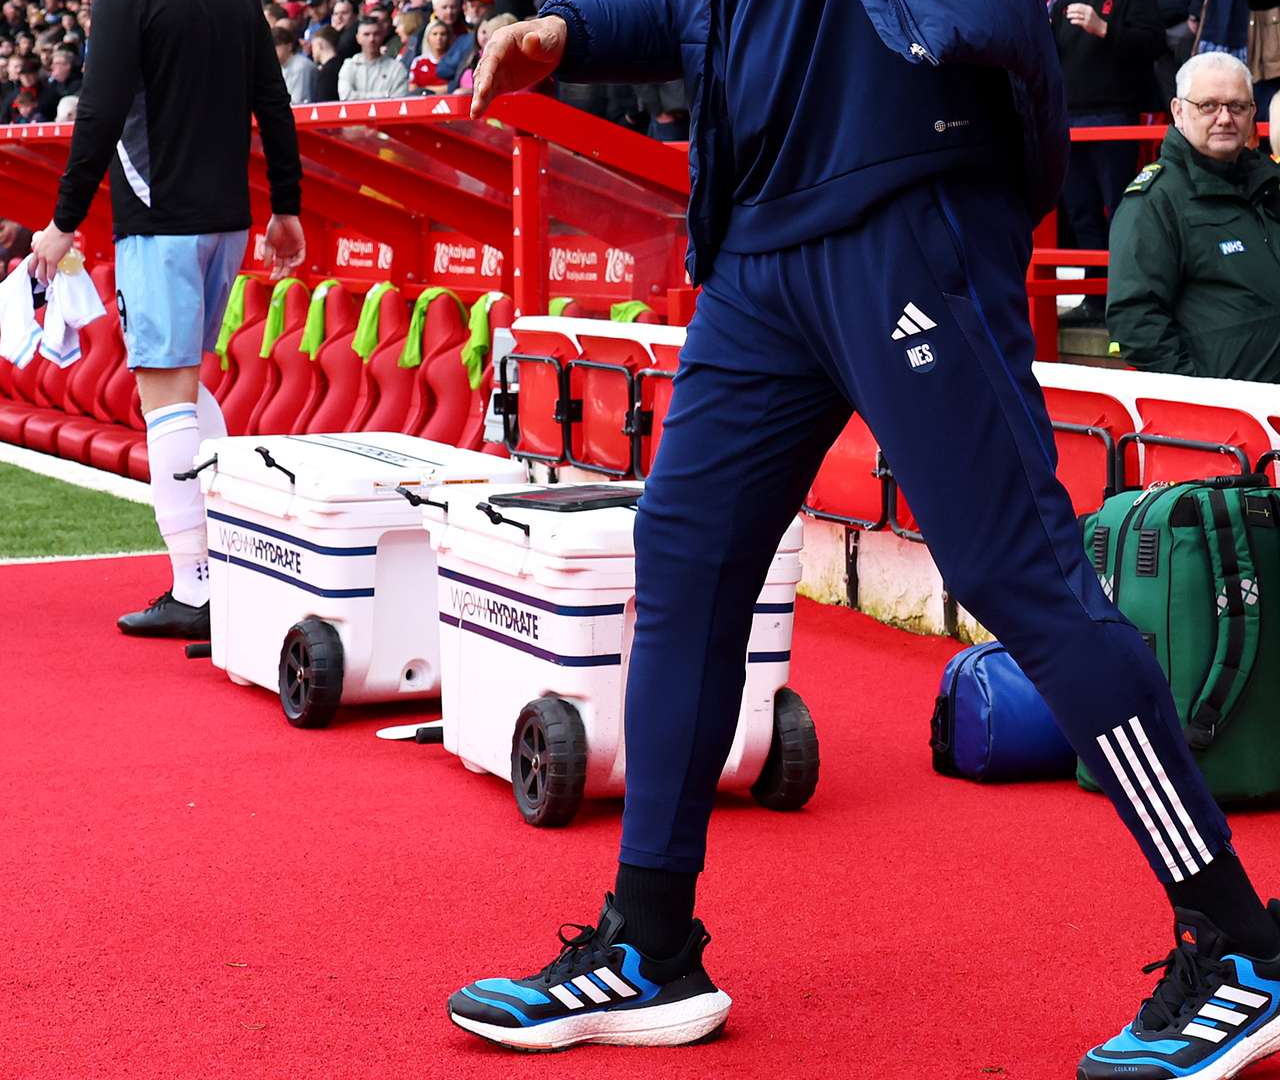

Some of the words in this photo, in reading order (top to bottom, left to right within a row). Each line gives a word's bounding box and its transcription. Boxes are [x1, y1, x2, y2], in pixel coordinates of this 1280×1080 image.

[1221, 240, 1245, 255] NHS
[566, 248, 597, 267] kaiyun
[906, 343, 934, 368] NES
